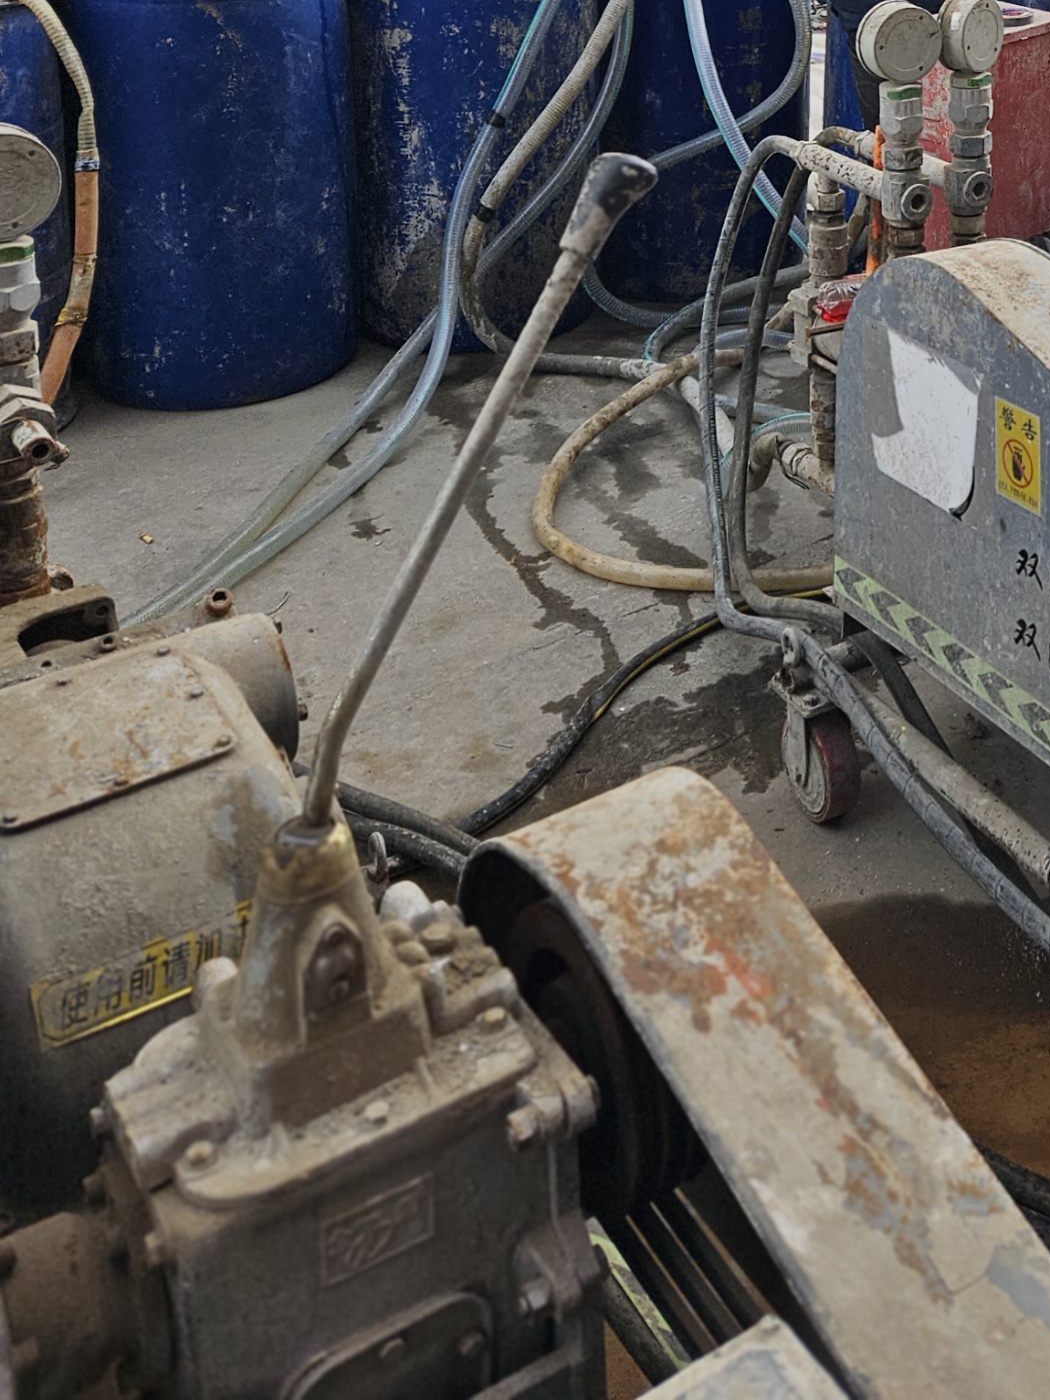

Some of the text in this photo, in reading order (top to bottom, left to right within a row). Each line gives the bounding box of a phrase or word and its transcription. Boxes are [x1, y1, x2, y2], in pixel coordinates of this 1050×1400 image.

[999, 406, 1038, 441] 警告
[61, 912, 249, 1030] 使用前请加
